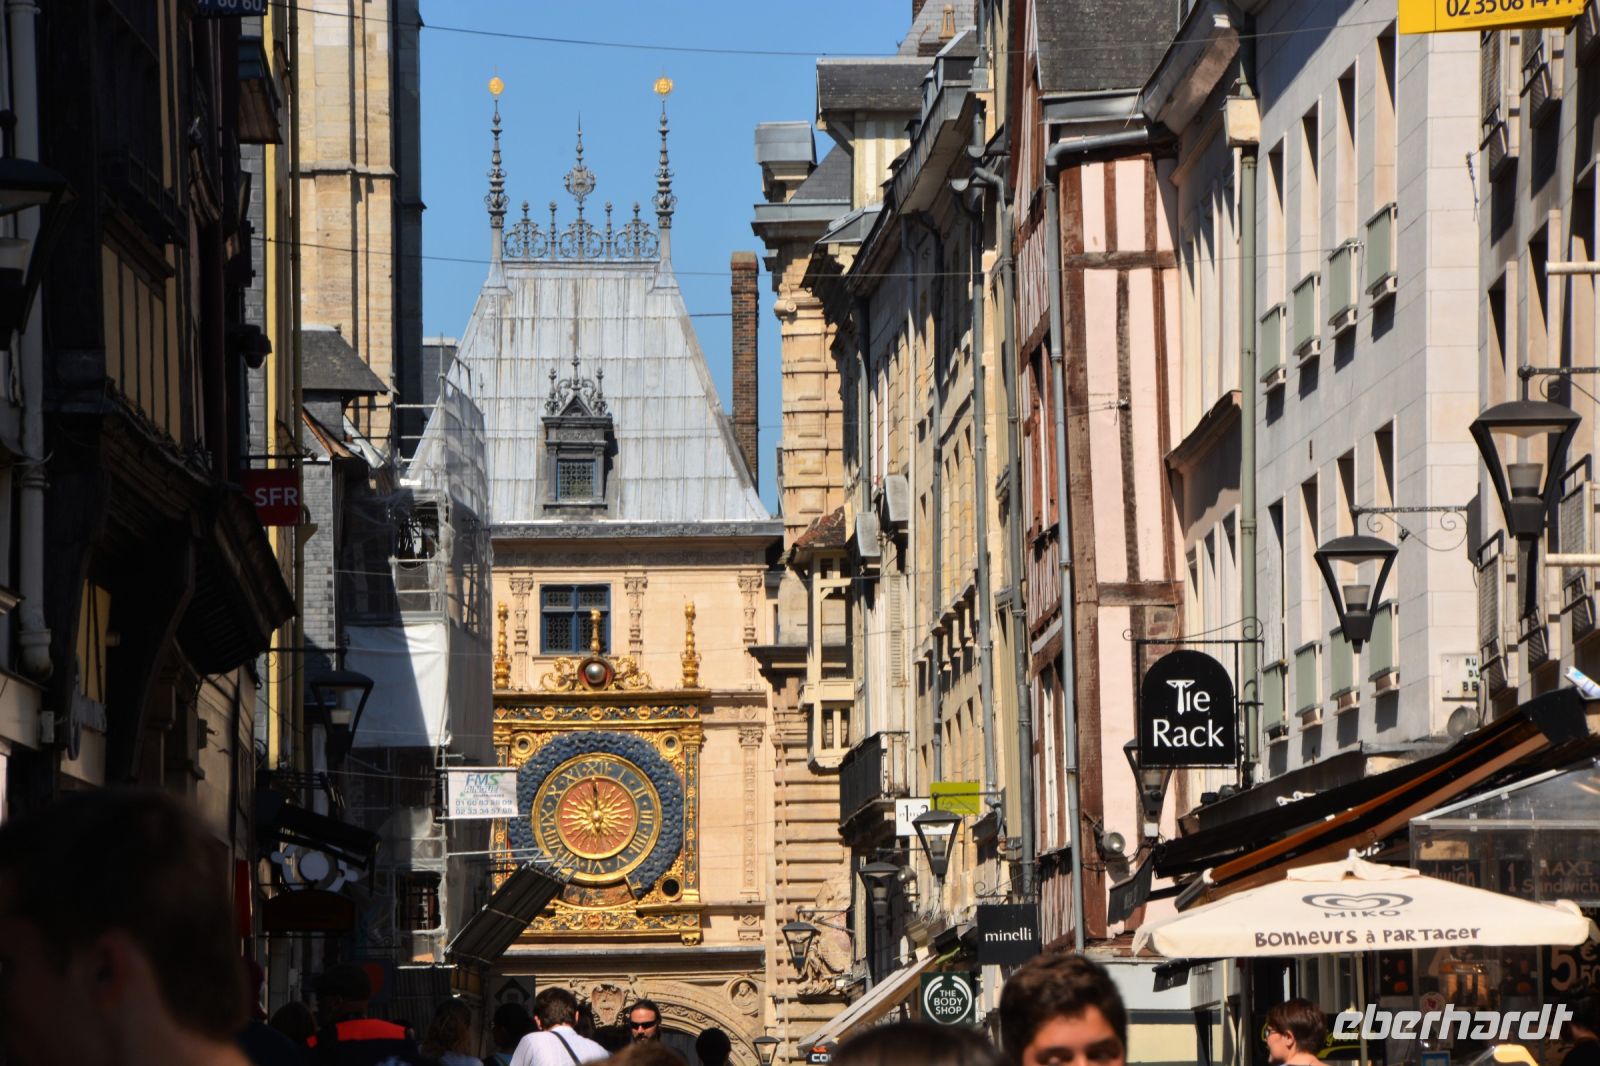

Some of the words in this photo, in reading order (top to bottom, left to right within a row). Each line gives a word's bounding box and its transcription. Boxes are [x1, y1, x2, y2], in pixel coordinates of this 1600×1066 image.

[1446, 0, 1470, 17] 02
[255, 487, 298, 507] SFR
[1166, 680, 1211, 715] Tie
[1153, 719, 1224, 748] Rack
[466, 774, 499, 786] FMS
[1324, 910, 1400, 919] MIKO
[985, 927, 1032, 942] minelli
[1551, 945, 1577, 992] 5
[940, 989, 956, 997] THE
[933, 997, 963, 1006] BODY
[935, 1006, 962, 1015] SHOP
